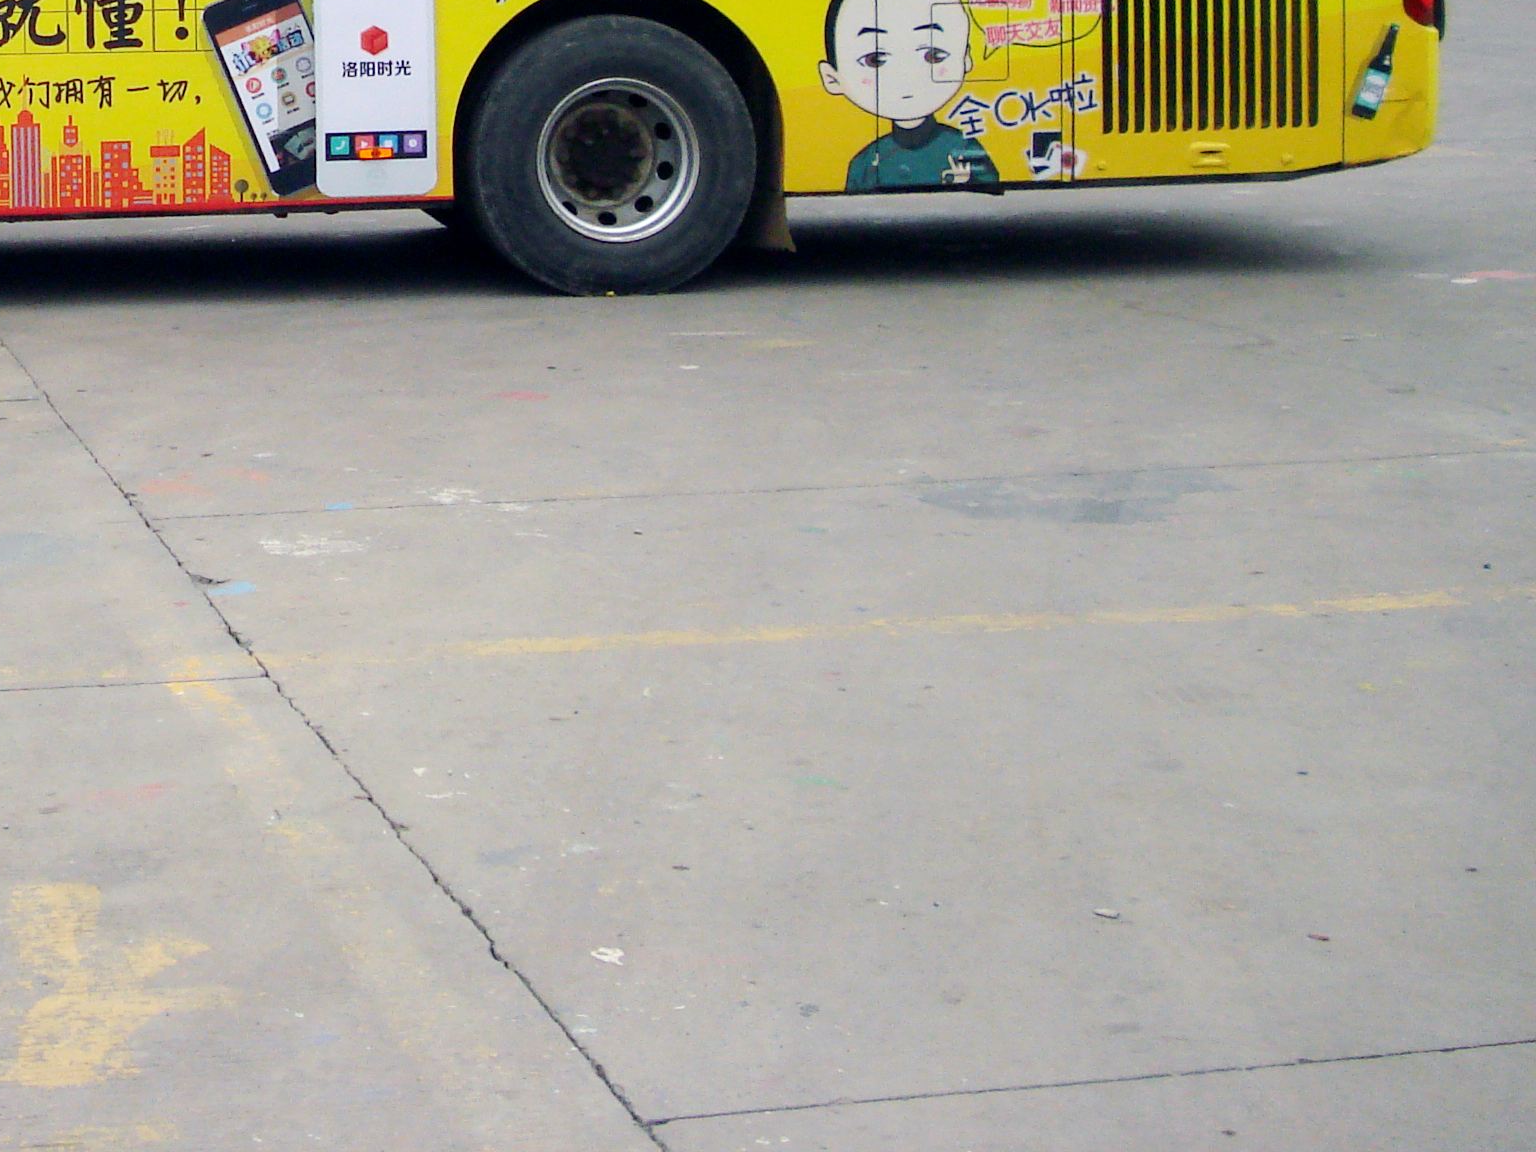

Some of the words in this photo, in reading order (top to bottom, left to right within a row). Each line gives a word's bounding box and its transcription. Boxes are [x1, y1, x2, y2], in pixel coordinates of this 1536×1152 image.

[986, 18, 1060, 44] 聊天交友
[342, 60, 411, 78] 洛阳时光
